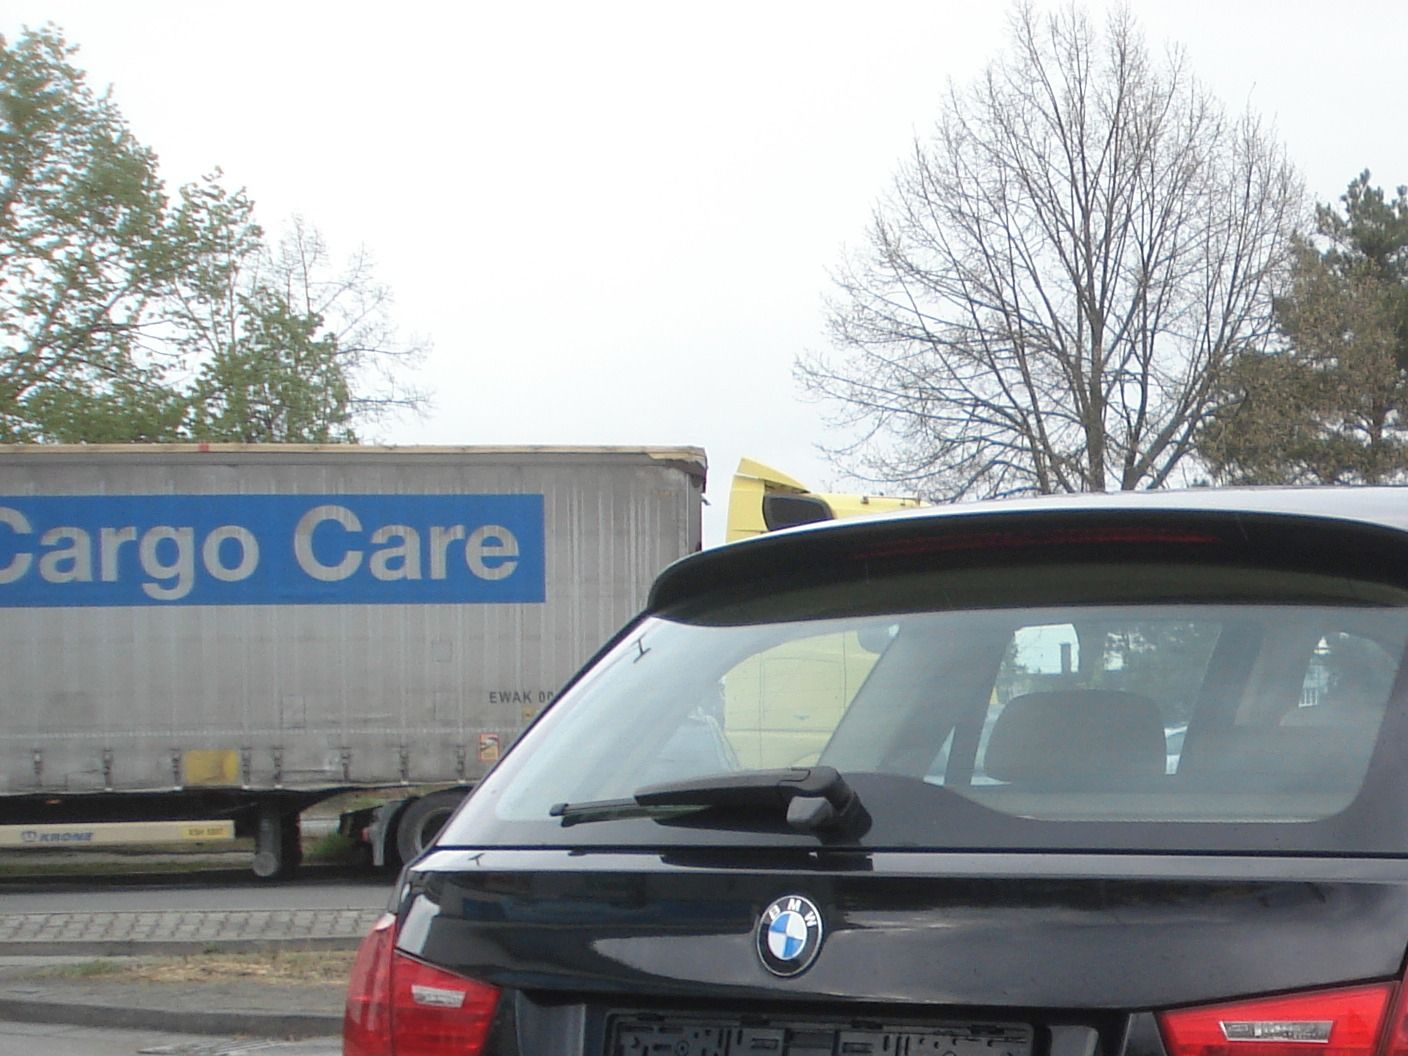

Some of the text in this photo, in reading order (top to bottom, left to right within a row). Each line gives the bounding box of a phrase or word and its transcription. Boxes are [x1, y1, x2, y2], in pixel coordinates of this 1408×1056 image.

[294, 504, 520, 582] Care
[489, 690, 532, 704] EWAK
[40, 832, 94, 842] KRONE
[768, 898, 817, 927] BMW
